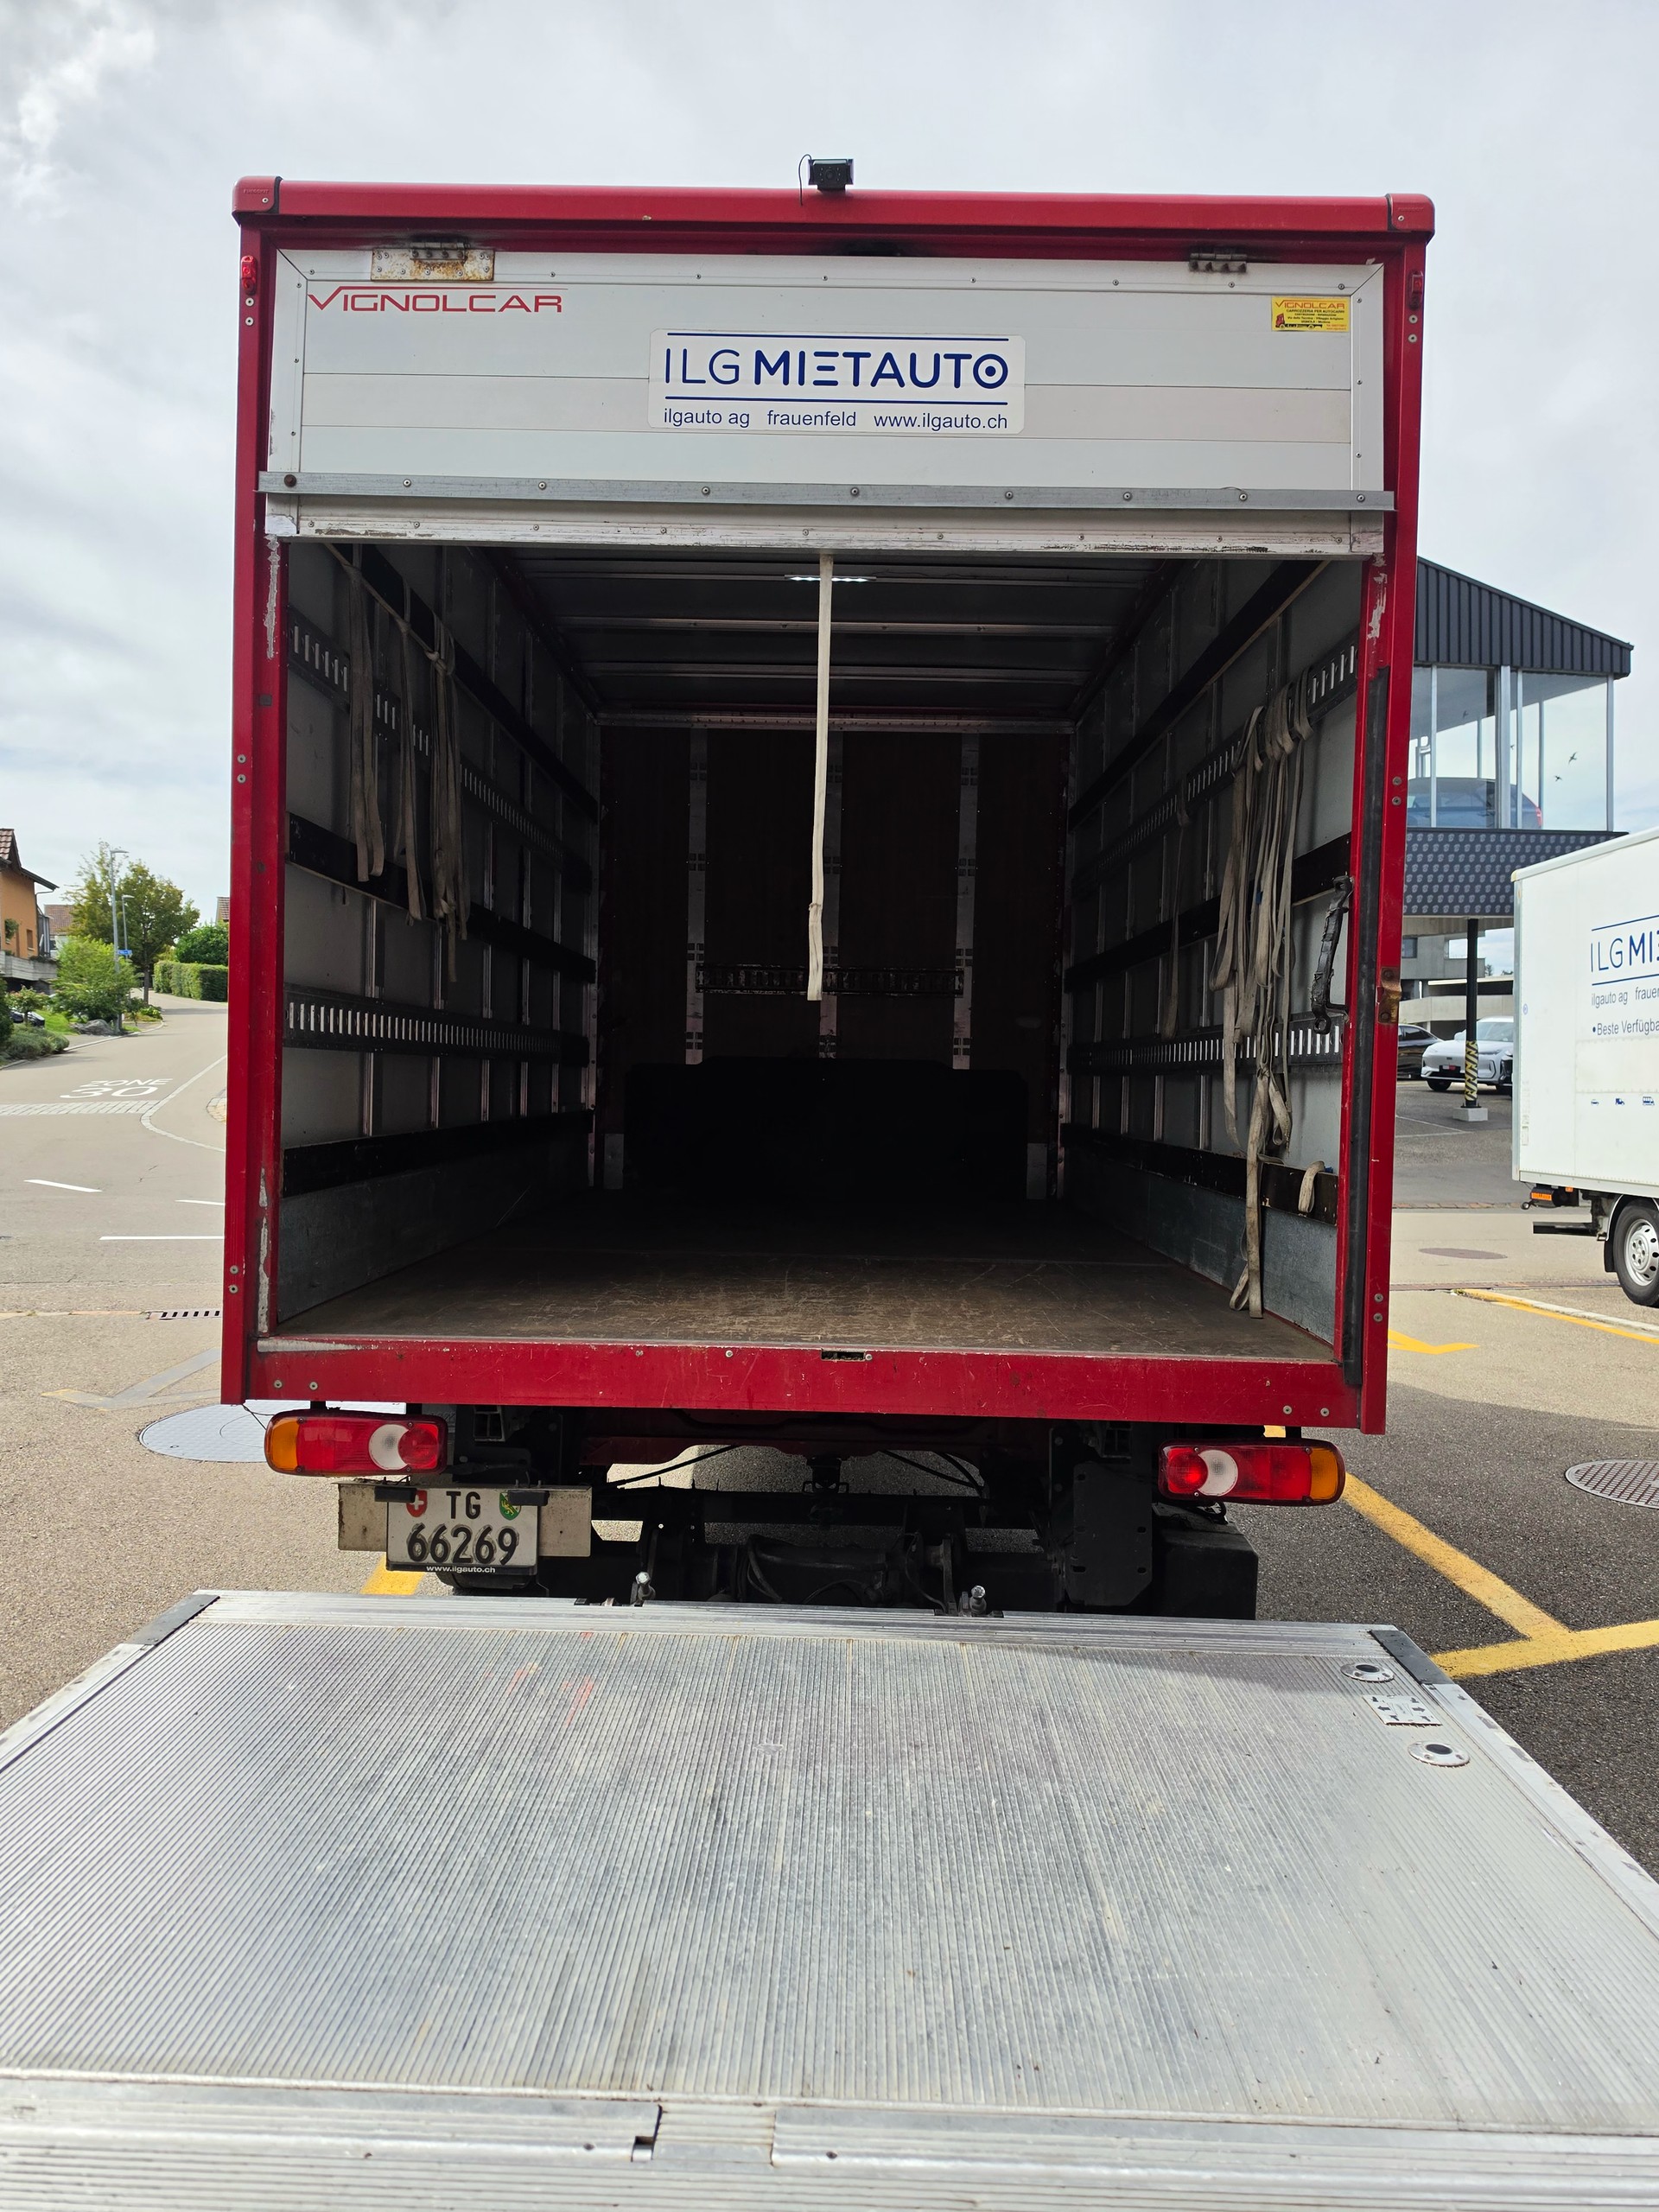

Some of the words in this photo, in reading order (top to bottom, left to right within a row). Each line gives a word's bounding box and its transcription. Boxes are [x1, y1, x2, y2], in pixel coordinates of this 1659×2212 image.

[307, 286, 568, 313] VIGNOLCAR
[1275, 300, 1345, 309] VIGNOLCAR
[665, 347, 741, 385] ILG
[753, 349, 1009, 390] MIETAUTO
[664, 408, 723, 427] ilgauto
[728, 413, 750, 428] ag
[767, 410, 856, 428] frauenfeld
[874, 412, 1008, 430] www.ilgauto.ch
[1590, 938, 1624, 973] ILG
[1629, 930, 1659, 967] MI
[1591, 991, 1617, 1009] ilgauto
[1618, 991, 1629, 1006] ag
[1597, 1022, 1619, 1036] Beste
[60, 1085, 159, 1099] 30
[79, 1077, 174, 1088] ZONE
[445, 1491, 481, 1520] TG
[406, 1522, 519, 1566] 66269
[426, 1564, 496, 1574] www.ilgauto.ch
